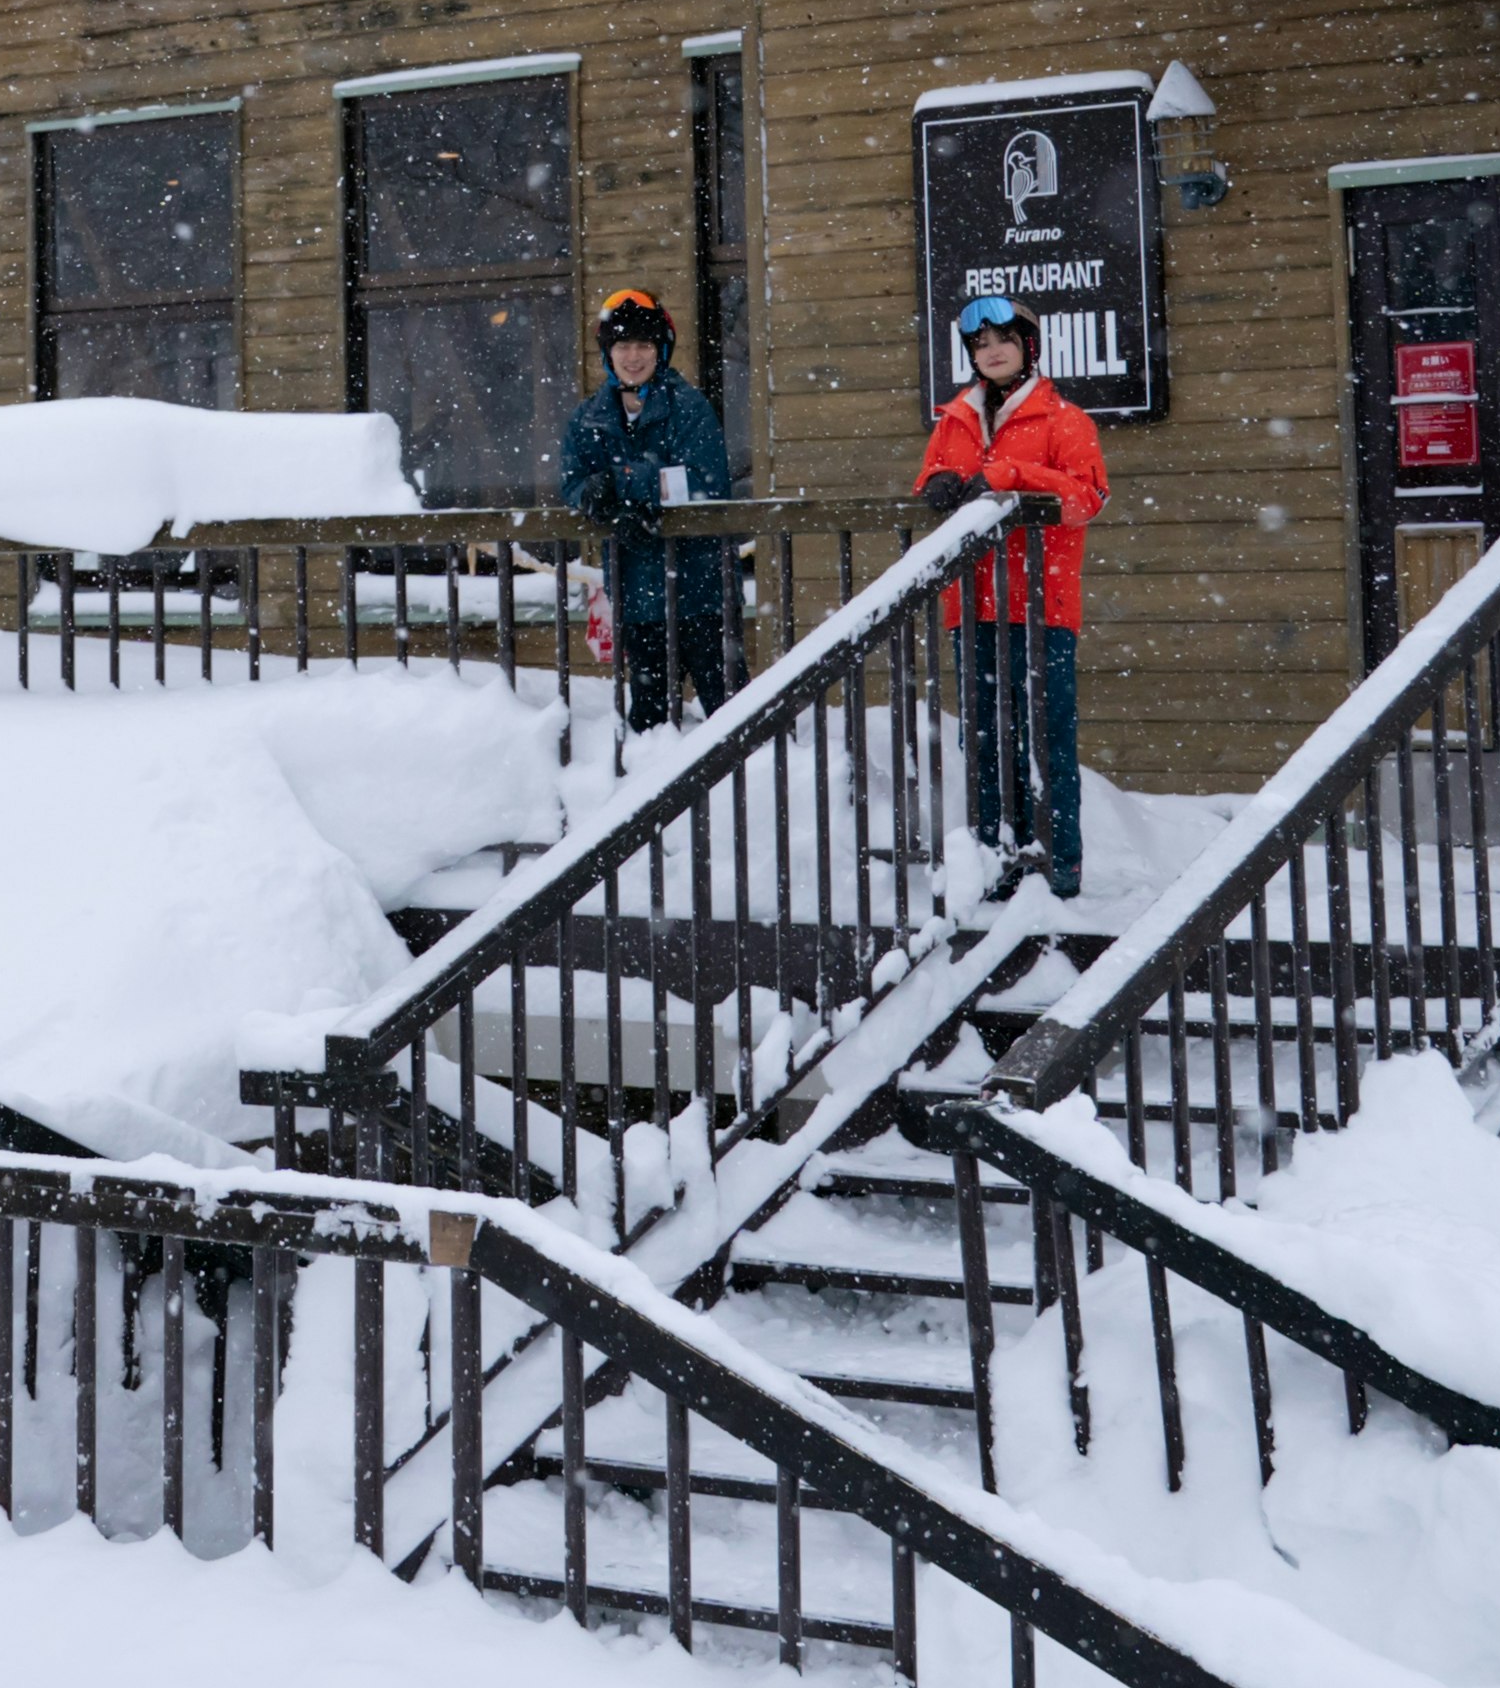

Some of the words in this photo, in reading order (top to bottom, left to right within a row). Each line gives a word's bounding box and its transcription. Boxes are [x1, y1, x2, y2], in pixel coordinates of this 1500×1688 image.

[1004, 227, 1062, 244] Furano
[965, 259, 1104, 296] RESTAURANT
[950, 310, 1127, 384] DHILL
